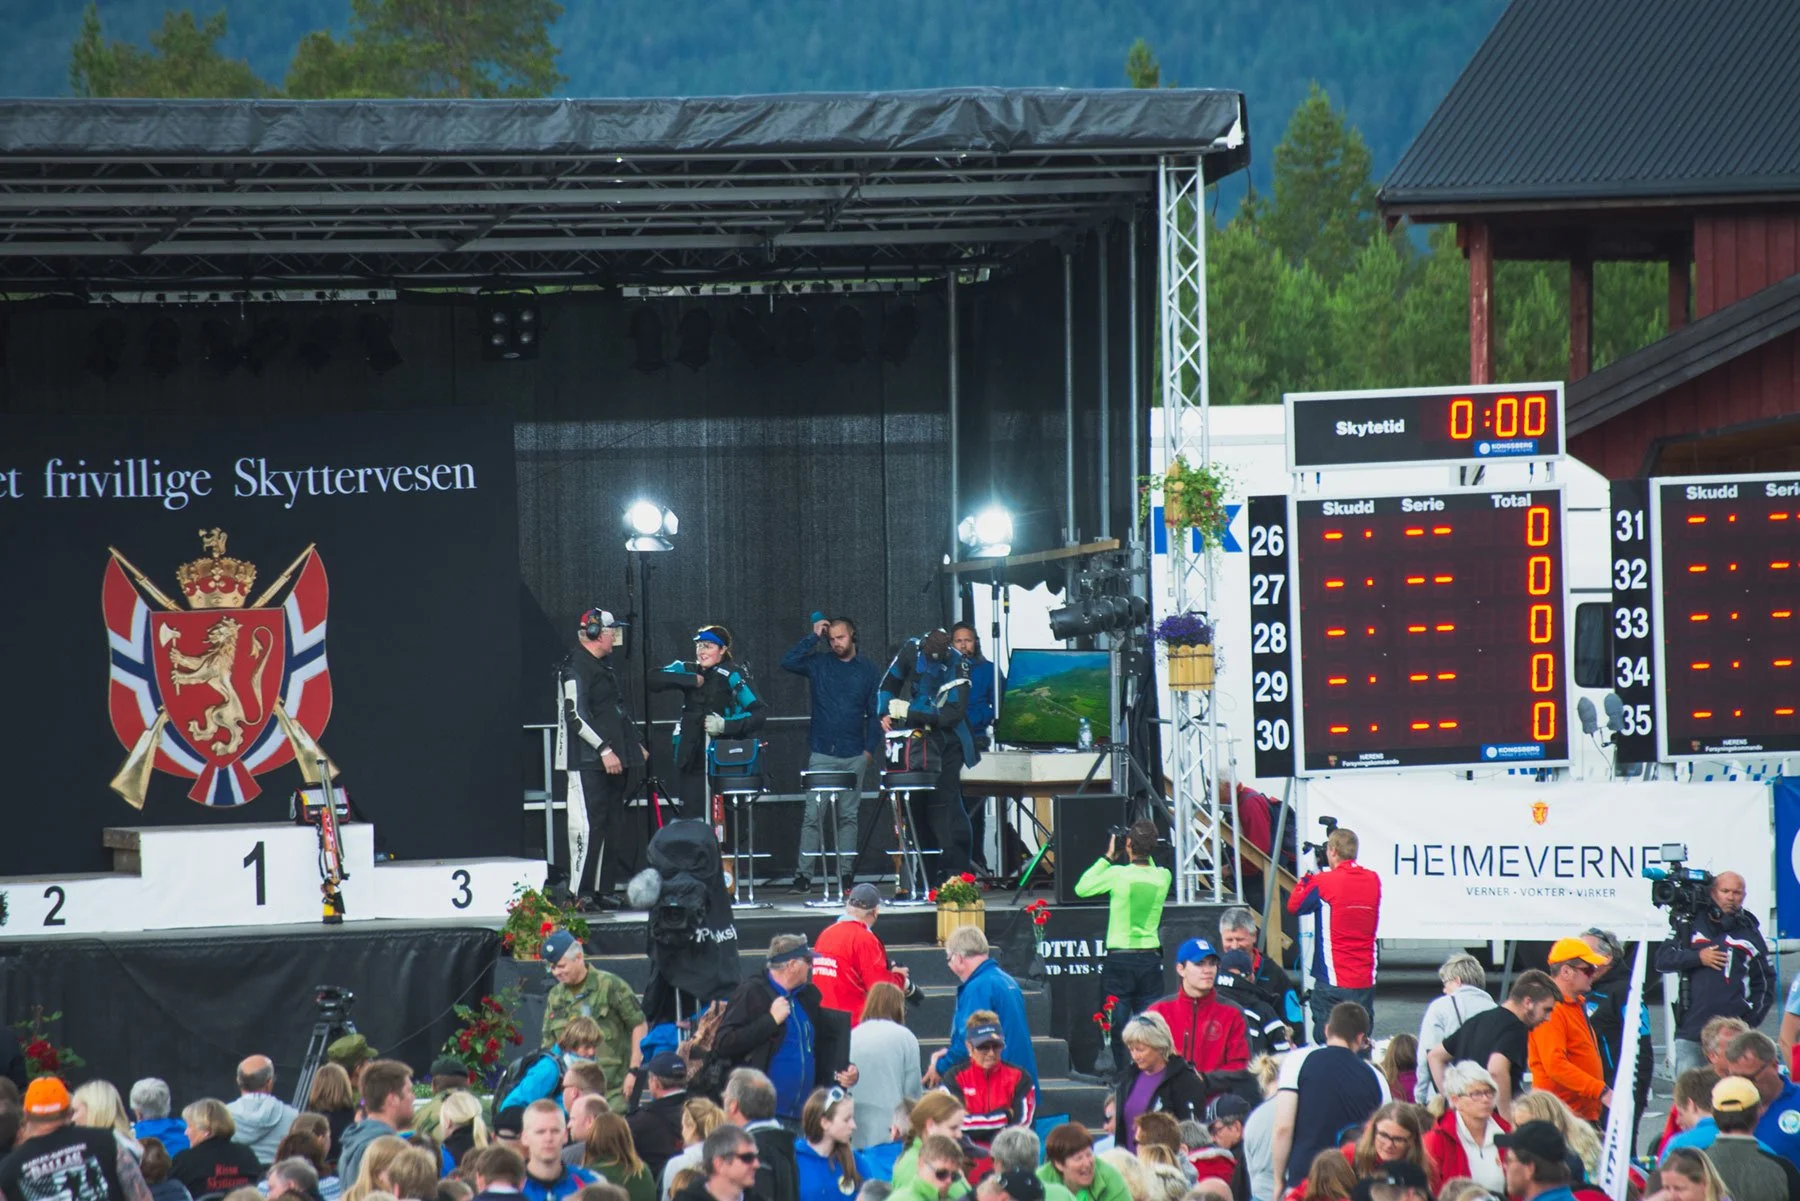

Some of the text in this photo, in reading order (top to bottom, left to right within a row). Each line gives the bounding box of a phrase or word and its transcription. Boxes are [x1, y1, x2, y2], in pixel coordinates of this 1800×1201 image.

[1336, 419, 1405, 437] Skytetid
[44, 457, 212, 510] frivillige
[234, 457, 477, 509] Skyttervesen
[1686, 482, 1800, 500] Skudd Seri
[1322, 493, 1532, 516] Skudd Serie Total
[1250, 525, 1285, 557] 26
[1527, 507, 1549, 547] 0
[1615, 510, 1644, 541] 31
[1252, 574, 1286, 605] 27
[1528, 556, 1551, 595] 0
[1614, 558, 1648, 590] 32
[1253, 622, 1287, 653] 28
[1530, 604, 1552, 643] 0
[1615, 607, 1649, 639] 33
[1255, 671, 1288, 702] 29
[1532, 653, 1553, 692] 0
[1616, 656, 1650, 688] 34
[1256, 719, 1290, 751] 30
[1533, 701, 1555, 740] 0
[1621, 705, 1652, 736] 35
[243, 841, 266, 905] 1
[451, 869, 473, 908] 3
[43, 885, 66, 926] 2
[1466, 887, 1616, 898] VERNER VOKTER VIRKER
[1039, 940, 1091, 957] OTTA
[1045, 964, 1061, 975] YD
[1069, 964, 1089, 974] LYS
